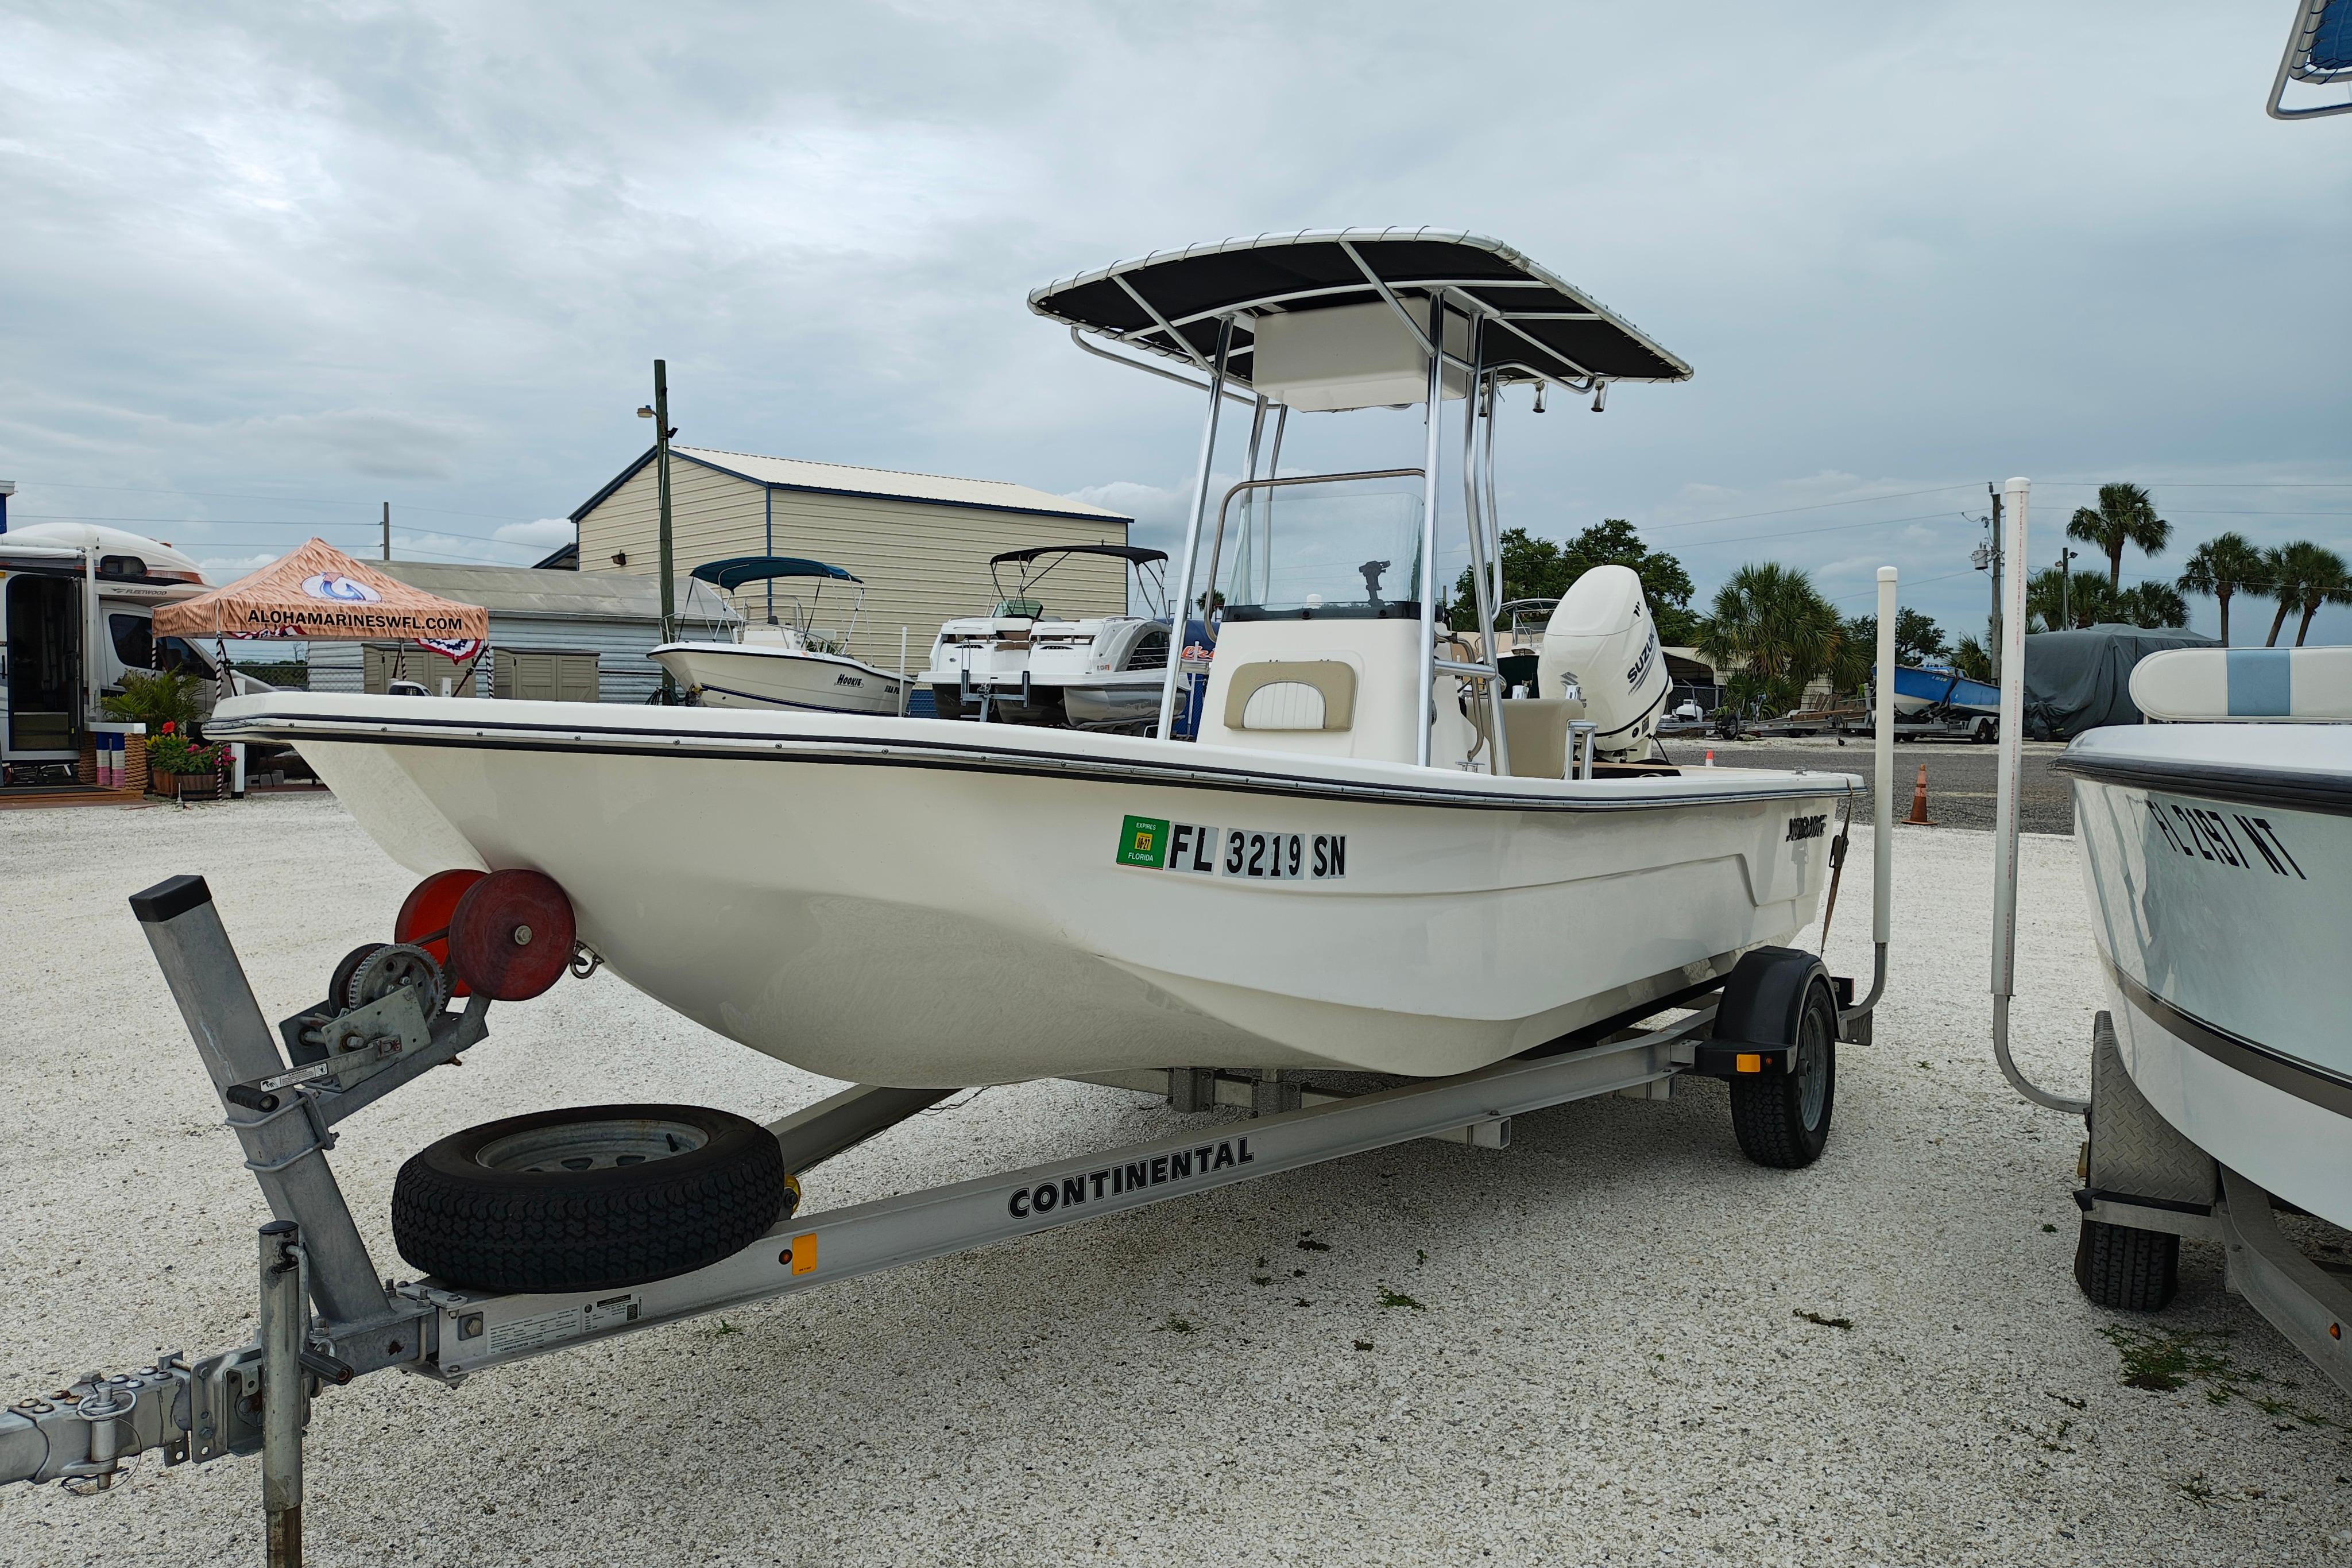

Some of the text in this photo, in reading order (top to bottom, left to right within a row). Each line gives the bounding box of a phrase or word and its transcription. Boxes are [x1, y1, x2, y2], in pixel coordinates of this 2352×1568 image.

[247, 610, 462, 630] ALOHAMARINESWFL.COM
[837, 673, 862, 686] HOOKIE
[1136, 822, 1156, 830] EXPIRES
[2144, 799, 2307, 880] FL 2197 NT
[1128, 852, 1154, 862] FLORIDA
[1169, 824, 1345, 877] FL 3219 SN
[1008, 1136, 1255, 1219] CONTINENTAL
